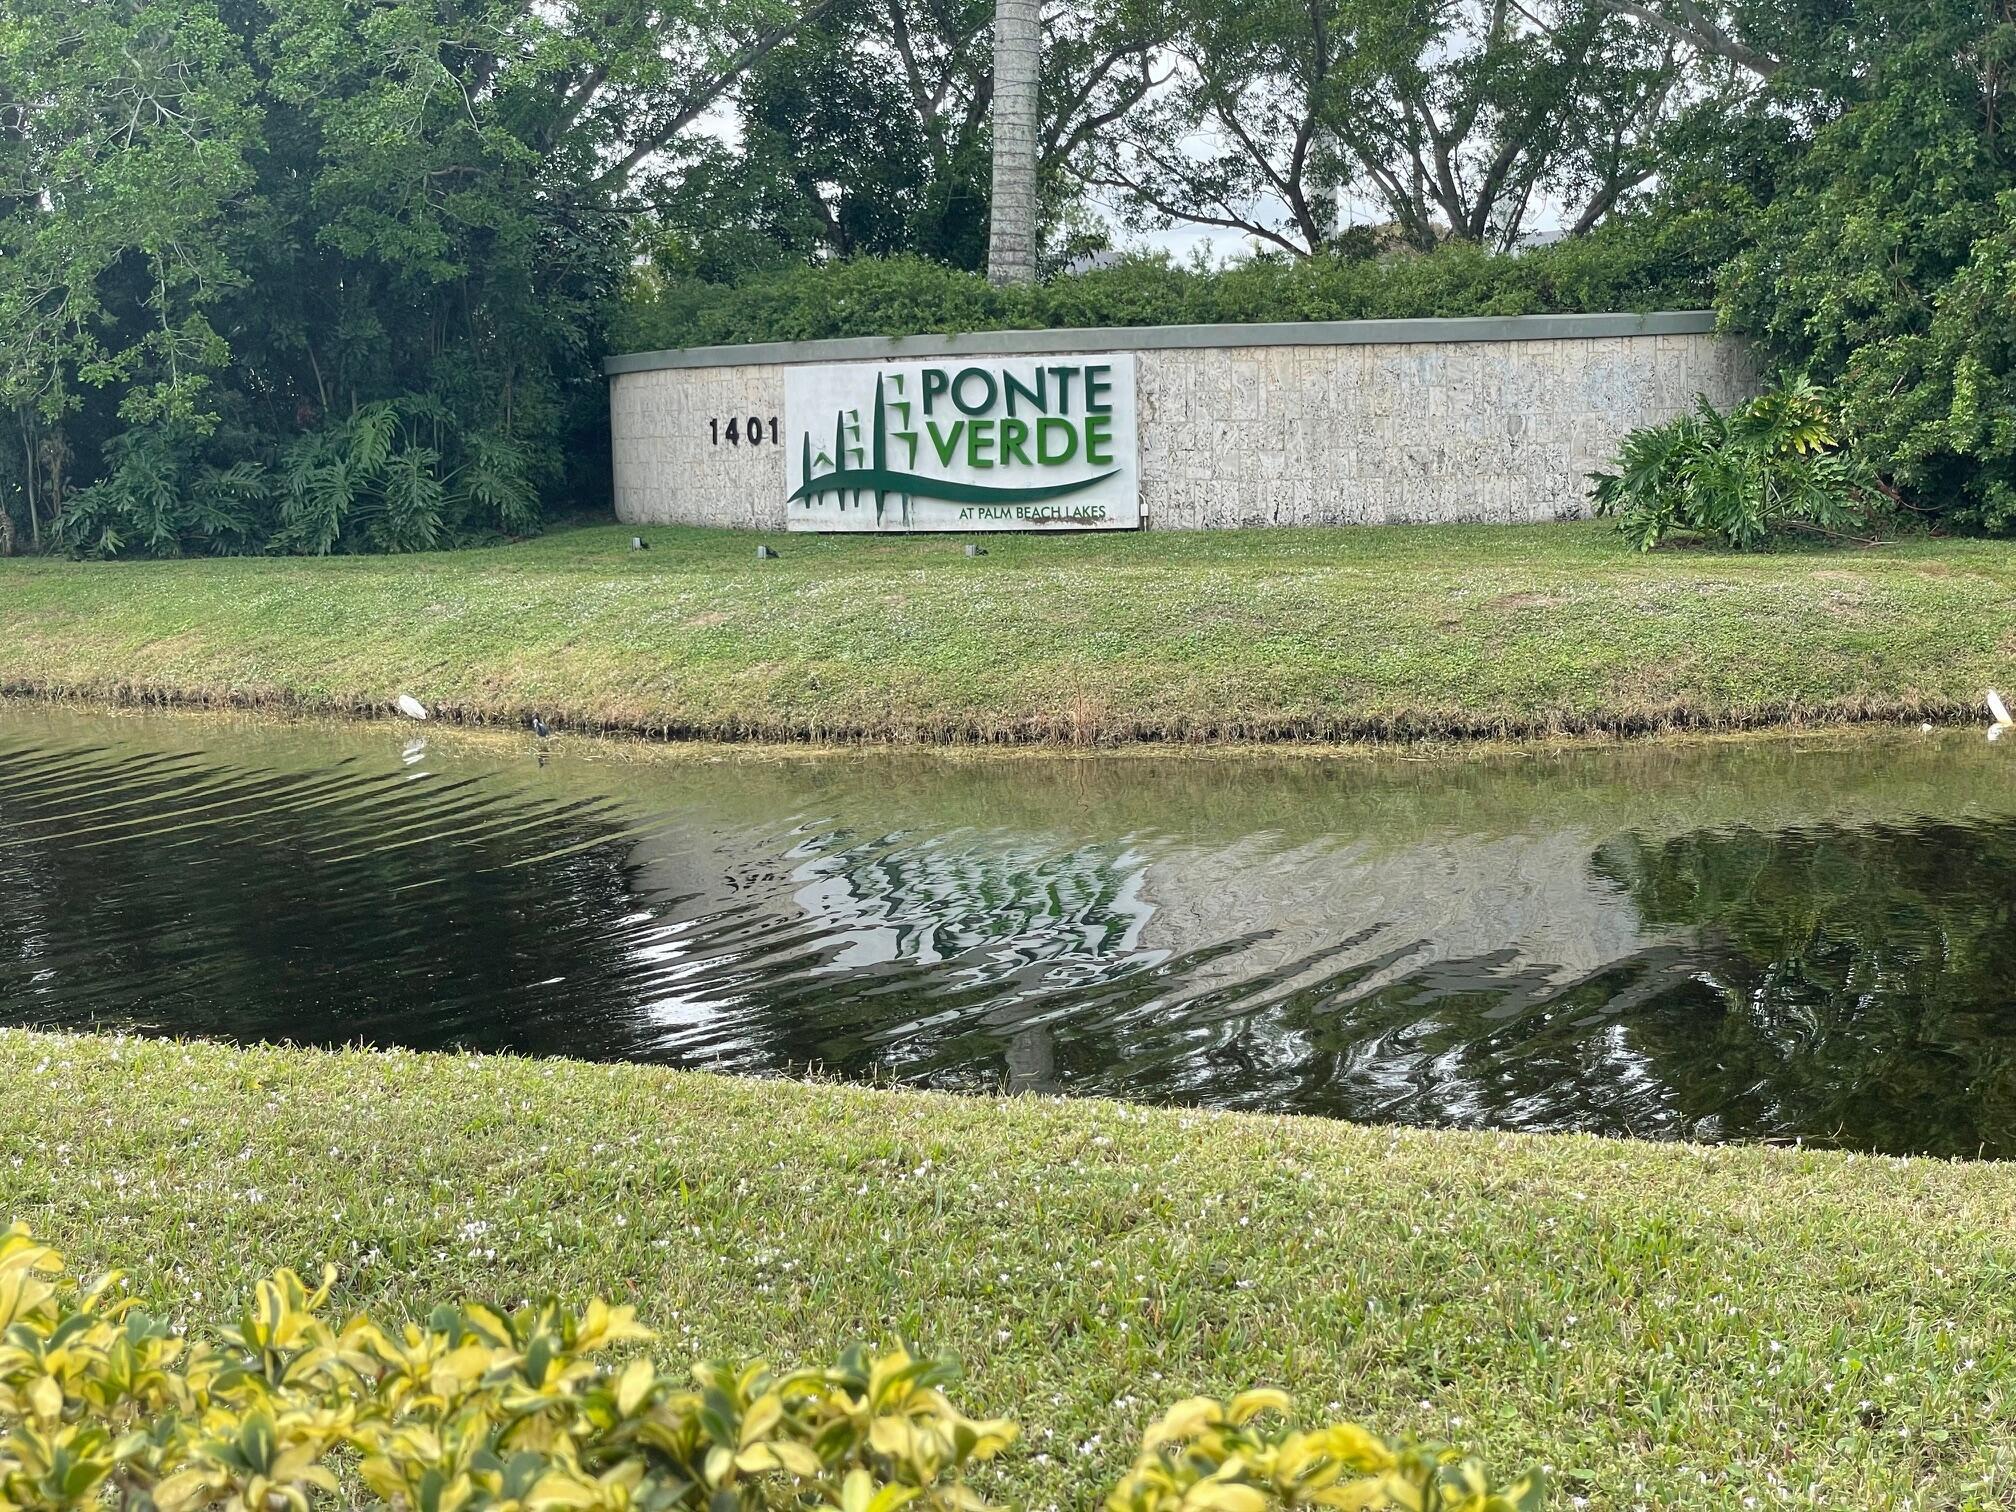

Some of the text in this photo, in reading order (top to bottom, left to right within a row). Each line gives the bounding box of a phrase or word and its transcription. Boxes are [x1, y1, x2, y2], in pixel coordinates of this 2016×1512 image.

[921, 365, 1113, 417] PONTE
[709, 416, 779, 446] 1401
[925, 415, 1114, 468] VERDE
[959, 505, 1106, 520] AT PALM BEACH LAKES
